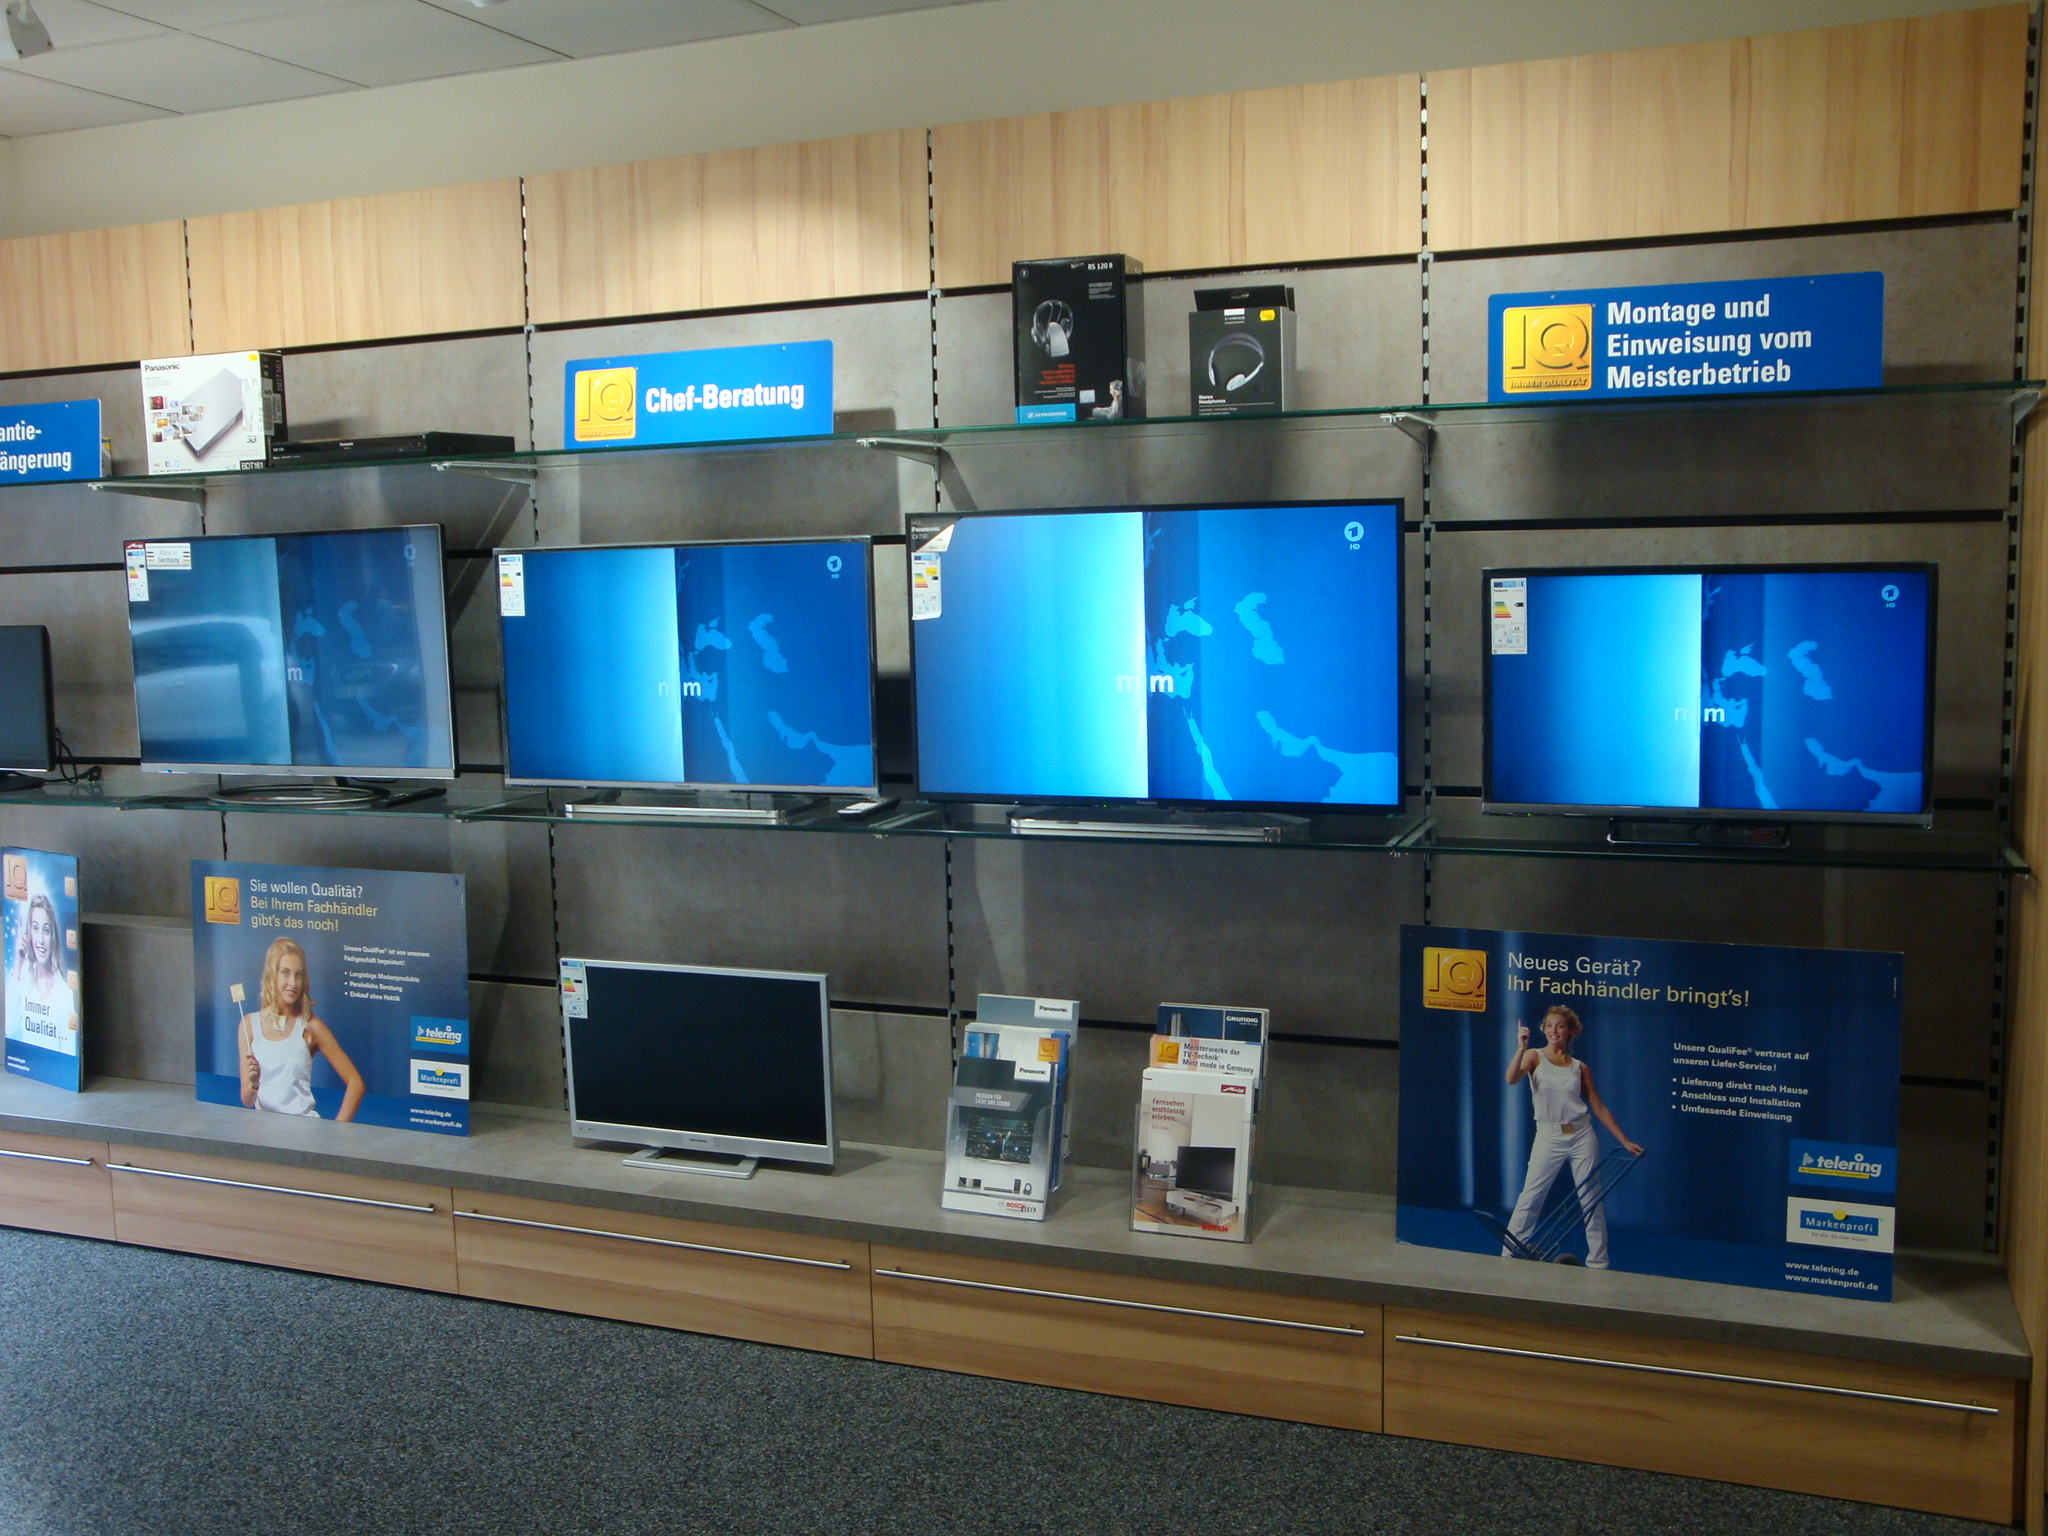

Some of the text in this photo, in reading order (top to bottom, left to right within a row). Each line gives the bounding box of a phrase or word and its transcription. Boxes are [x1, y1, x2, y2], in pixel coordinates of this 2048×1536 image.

[1087, 262, 1096, 270] RS
[1097, 261, 1108, 269] 120
[1607, 293, 1770, 327] Montage und
[1607, 329, 1812, 357] Einweisung vom
[144, 362, 180, 372] Panasonic
[1607, 358, 1791, 389] Meisterbetrieb
[646, 383, 805, 413] Chef-Beratung
[0, 451, 72, 474] ängerung
[241, 460, 264, 470] BDT161
[250, 879, 363, 898] Sie wollen Qualität?
[251, 896, 378, 917] Bei Ihrem Fachhändler
[251, 913, 281, 928] gibt's
[284, 916, 304, 929] das
[307, 918, 339, 931] noch!
[1507, 952, 1641, 976] Neues Gerät?
[378, 973, 420, 983] Markenprodukte
[349, 981, 403, 993] Persönliche Beratung
[349, 990, 369, 999] Einkauf
[369, 992, 383, 1000] ohne
[1508, 974, 1749, 1008] Ihr Fachhändler bringt's!
[25, 996, 50, 1016] Immer
[1039, 1005, 1069, 1013] Panasonic
[426, 1025, 462, 1043] telering
[1183, 1051, 1220, 1062] TV-Technik:
[1184, 1043, 1241, 1056] Meisterwerke der
[1673, 1042, 1705, 1052] Unsere
[1755, 1050, 1791, 1059] vertraut
[1794, 1052, 1809, 1060] auf
[1182, 1059, 1198, 1067] Metz
[1200, 1061, 1217, 1069] made
[1226, 1063, 1254, 1074] Germany
[1673, 1057, 1709, 1066] unseren
[420, 1073, 459, 1085] Markenprofi
[1019, 1067, 1047, 1075] Panasonic
[1681, 1077, 1809, 1095] Lieferung direkt nach Hause
[1152, 1098, 1185, 1106] Fernsehen
[1681, 1091, 1801, 1108] Anschluss und Installation
[410, 1108, 452, 1118] www.telering.de
[1151, 1107, 1186, 1116] erstklassig
[1681, 1104, 1792, 1123] Umfassende Einweisung
[410, 1117, 463, 1129] www.markenprofi.de
[1817, 1153, 1882, 1178] telering
[1805, 1216, 1874, 1233] Markenprofi
[1785, 1261, 1859, 1276] www.telering.de
[1785, 1273, 1879, 1291] www.markenprofi.de
